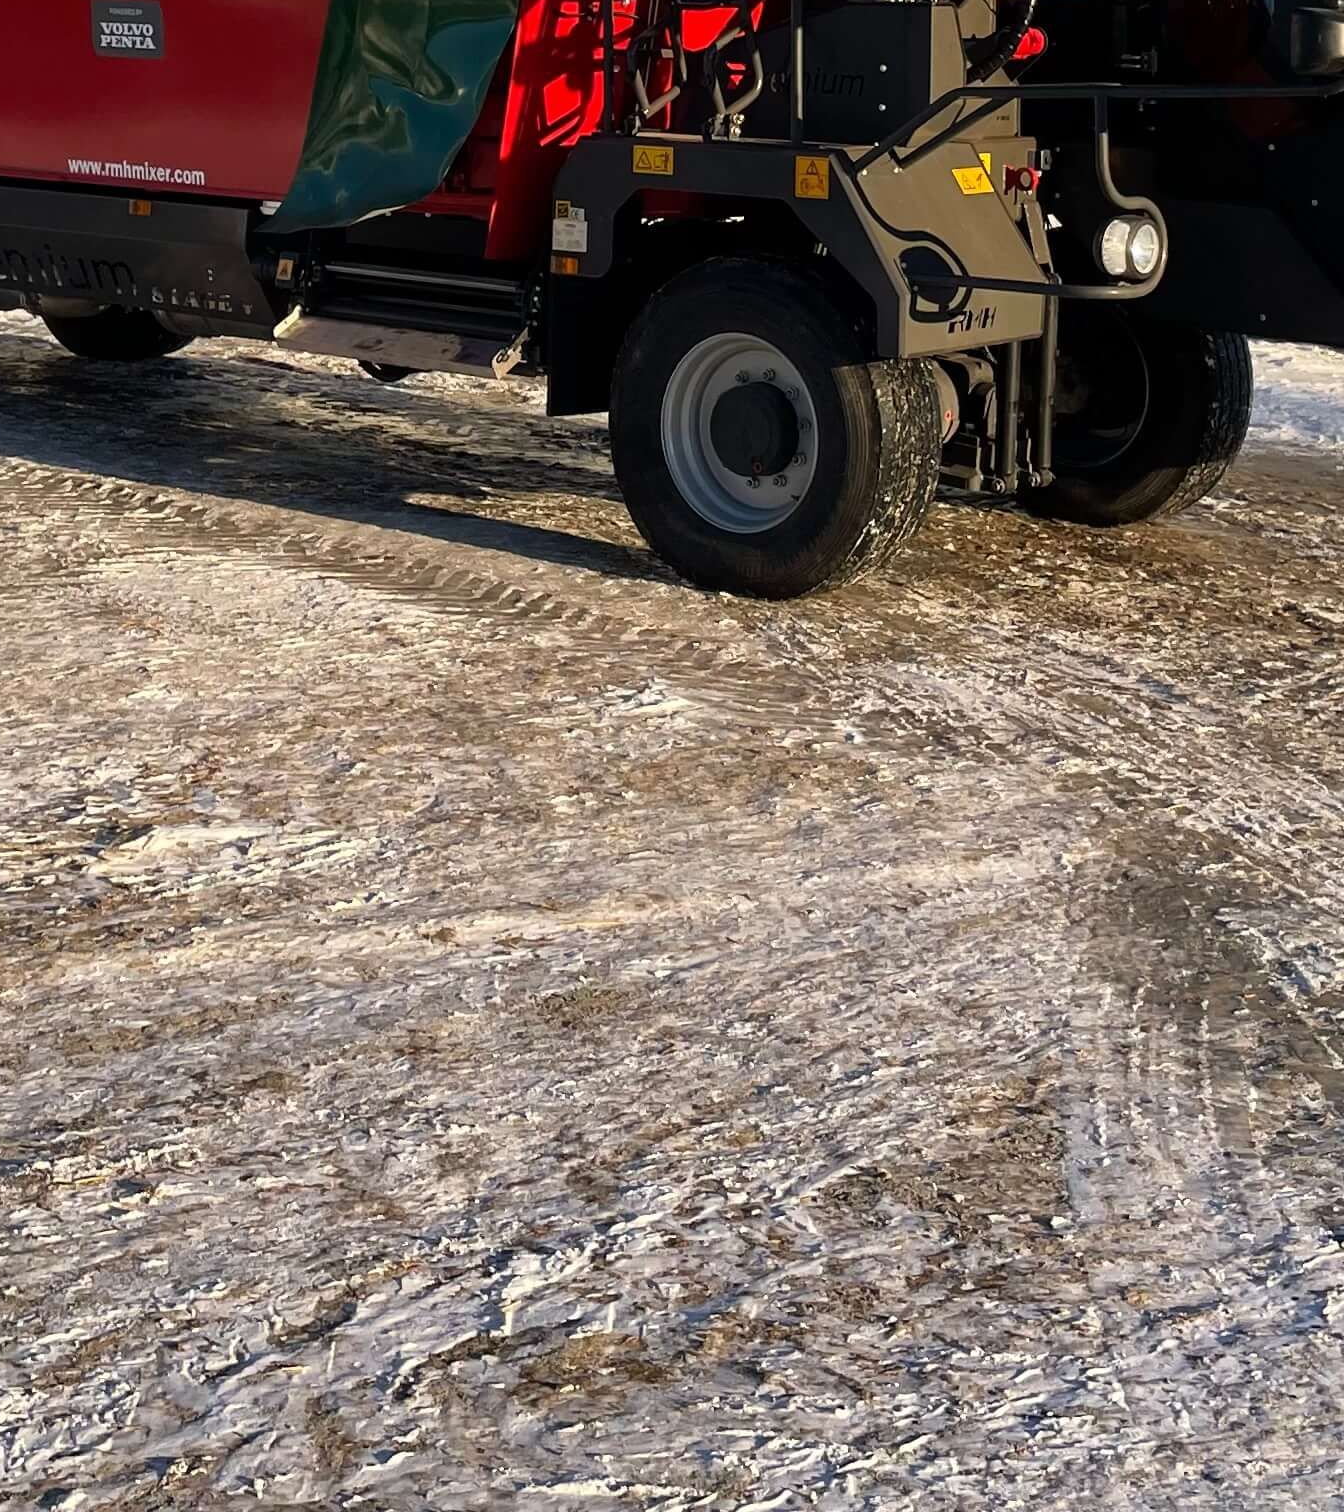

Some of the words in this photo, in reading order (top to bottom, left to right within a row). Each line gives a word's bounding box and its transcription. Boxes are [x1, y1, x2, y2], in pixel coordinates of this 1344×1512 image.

[99, 21, 154, 36] VOLVO
[100, 34, 157, 50] PENTA
[68, 159, 205, 186] www.rmhmixer.com
